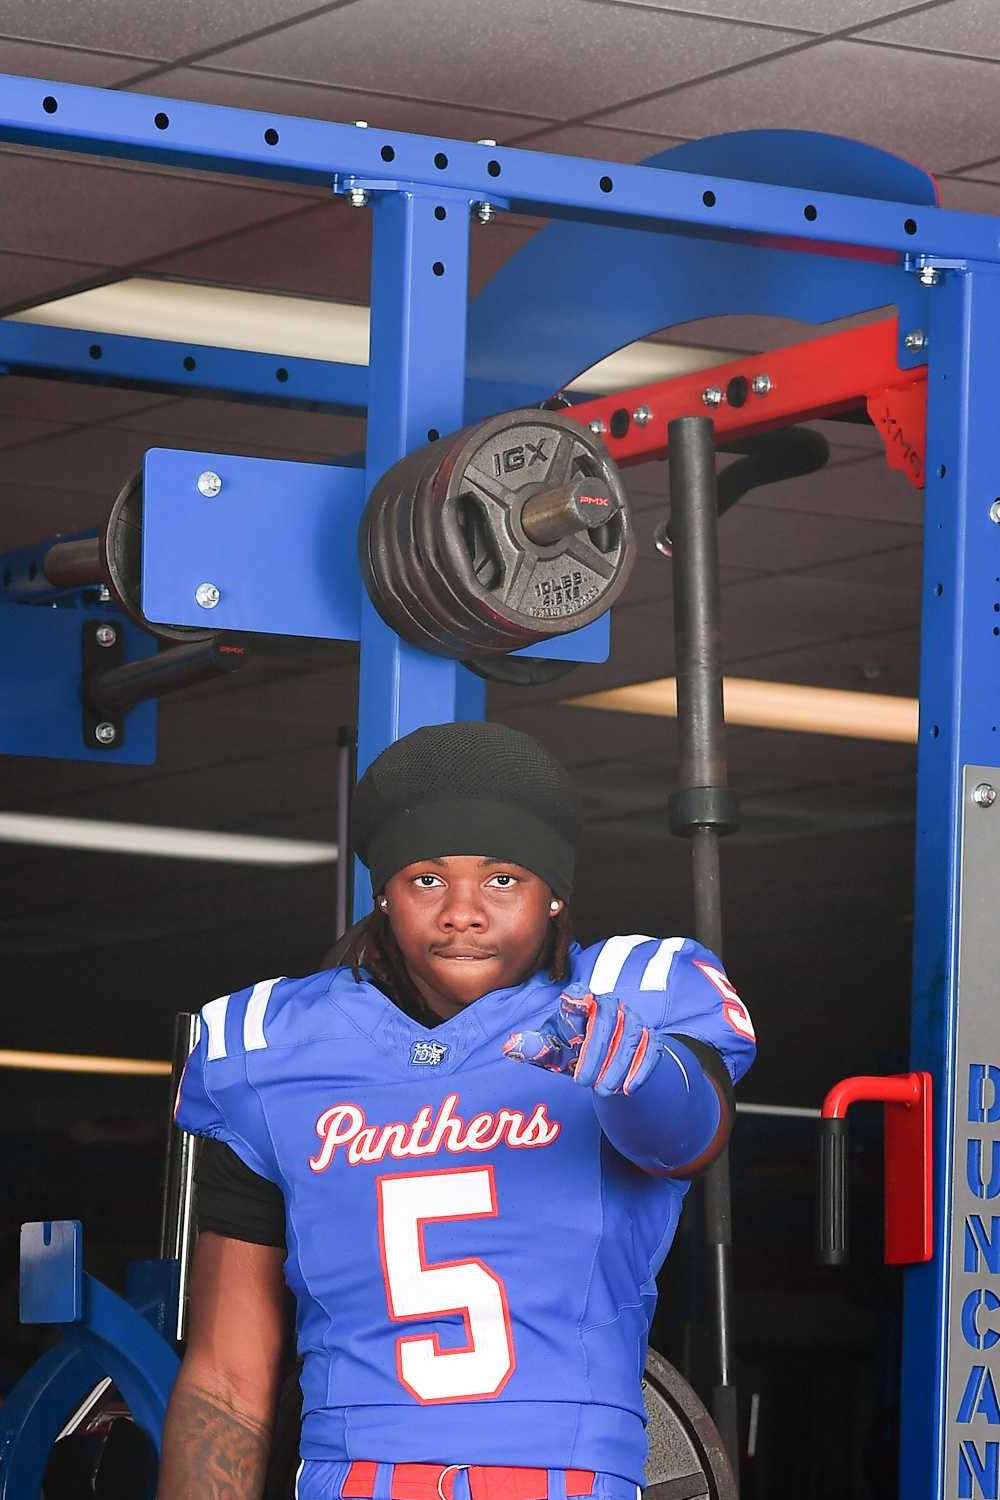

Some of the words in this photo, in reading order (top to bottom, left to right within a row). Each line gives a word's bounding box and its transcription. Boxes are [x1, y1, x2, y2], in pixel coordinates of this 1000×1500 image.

[492, 437, 547, 477] IGX
[579, 494, 609, 507] PMX
[692, 960, 756, 1042] 5
[308, 1092, 562, 1173] Panthers
[376, 1164, 517, 1405] 5
